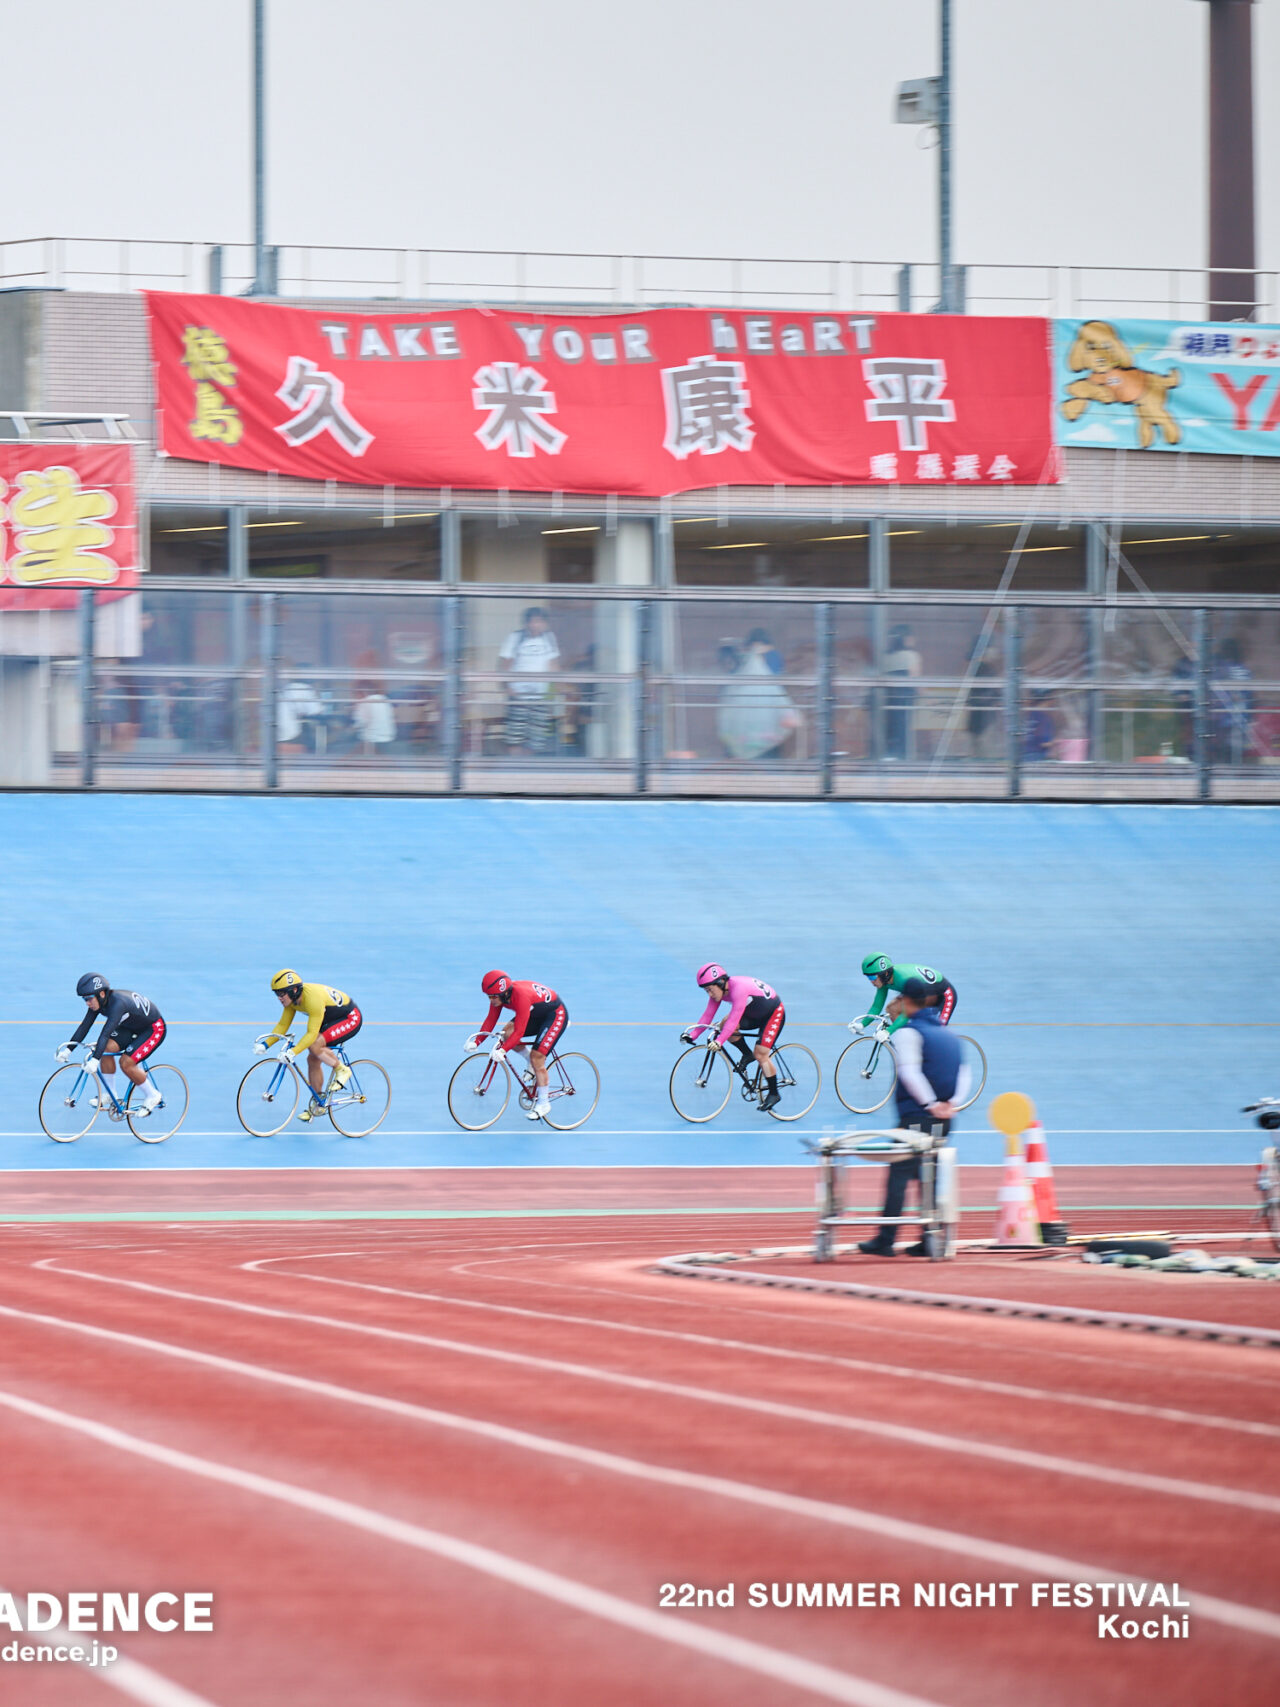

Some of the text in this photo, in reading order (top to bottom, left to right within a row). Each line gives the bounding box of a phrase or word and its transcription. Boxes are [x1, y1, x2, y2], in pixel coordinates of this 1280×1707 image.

[319, 321, 460, 362] TAKE
[181, 325, 245, 446] 徳島
[1208, 372, 1280, 432] Y
[274, 355, 955, 459] 久米康平
[531, 983, 551, 1003] 3
[915, 964, 937, 985] 6
[131, 992, 151, 1017] 2
